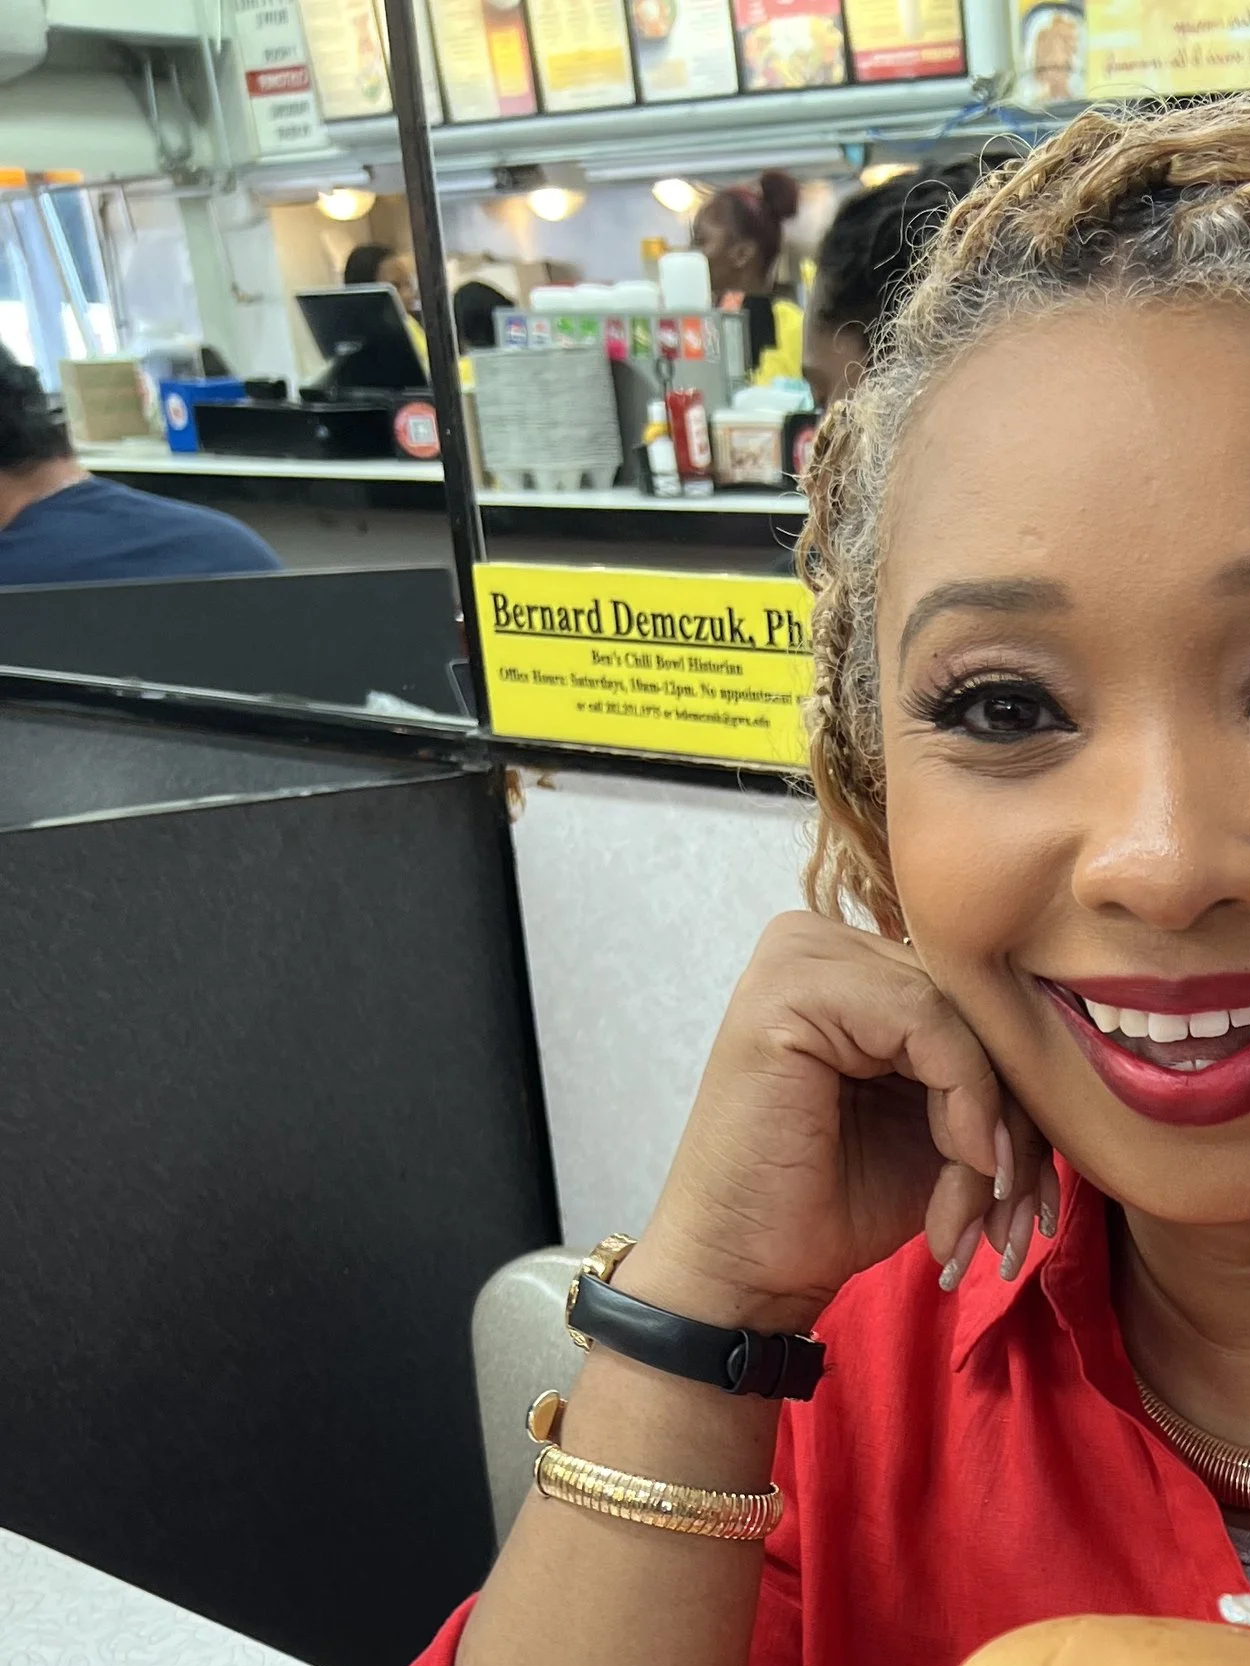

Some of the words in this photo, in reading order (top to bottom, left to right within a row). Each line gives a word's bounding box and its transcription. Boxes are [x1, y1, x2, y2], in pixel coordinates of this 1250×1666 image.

[491, 592, 604, 636] Bernard
[611, 600, 756, 649] Demczuk,
[498, 666, 529, 683] Office
[592, 648, 622, 668] Ben's
[625, 652, 652, 669] Chili
[655, 655, 685, 672] Bowl
[688, 657, 743, 676] Historian
